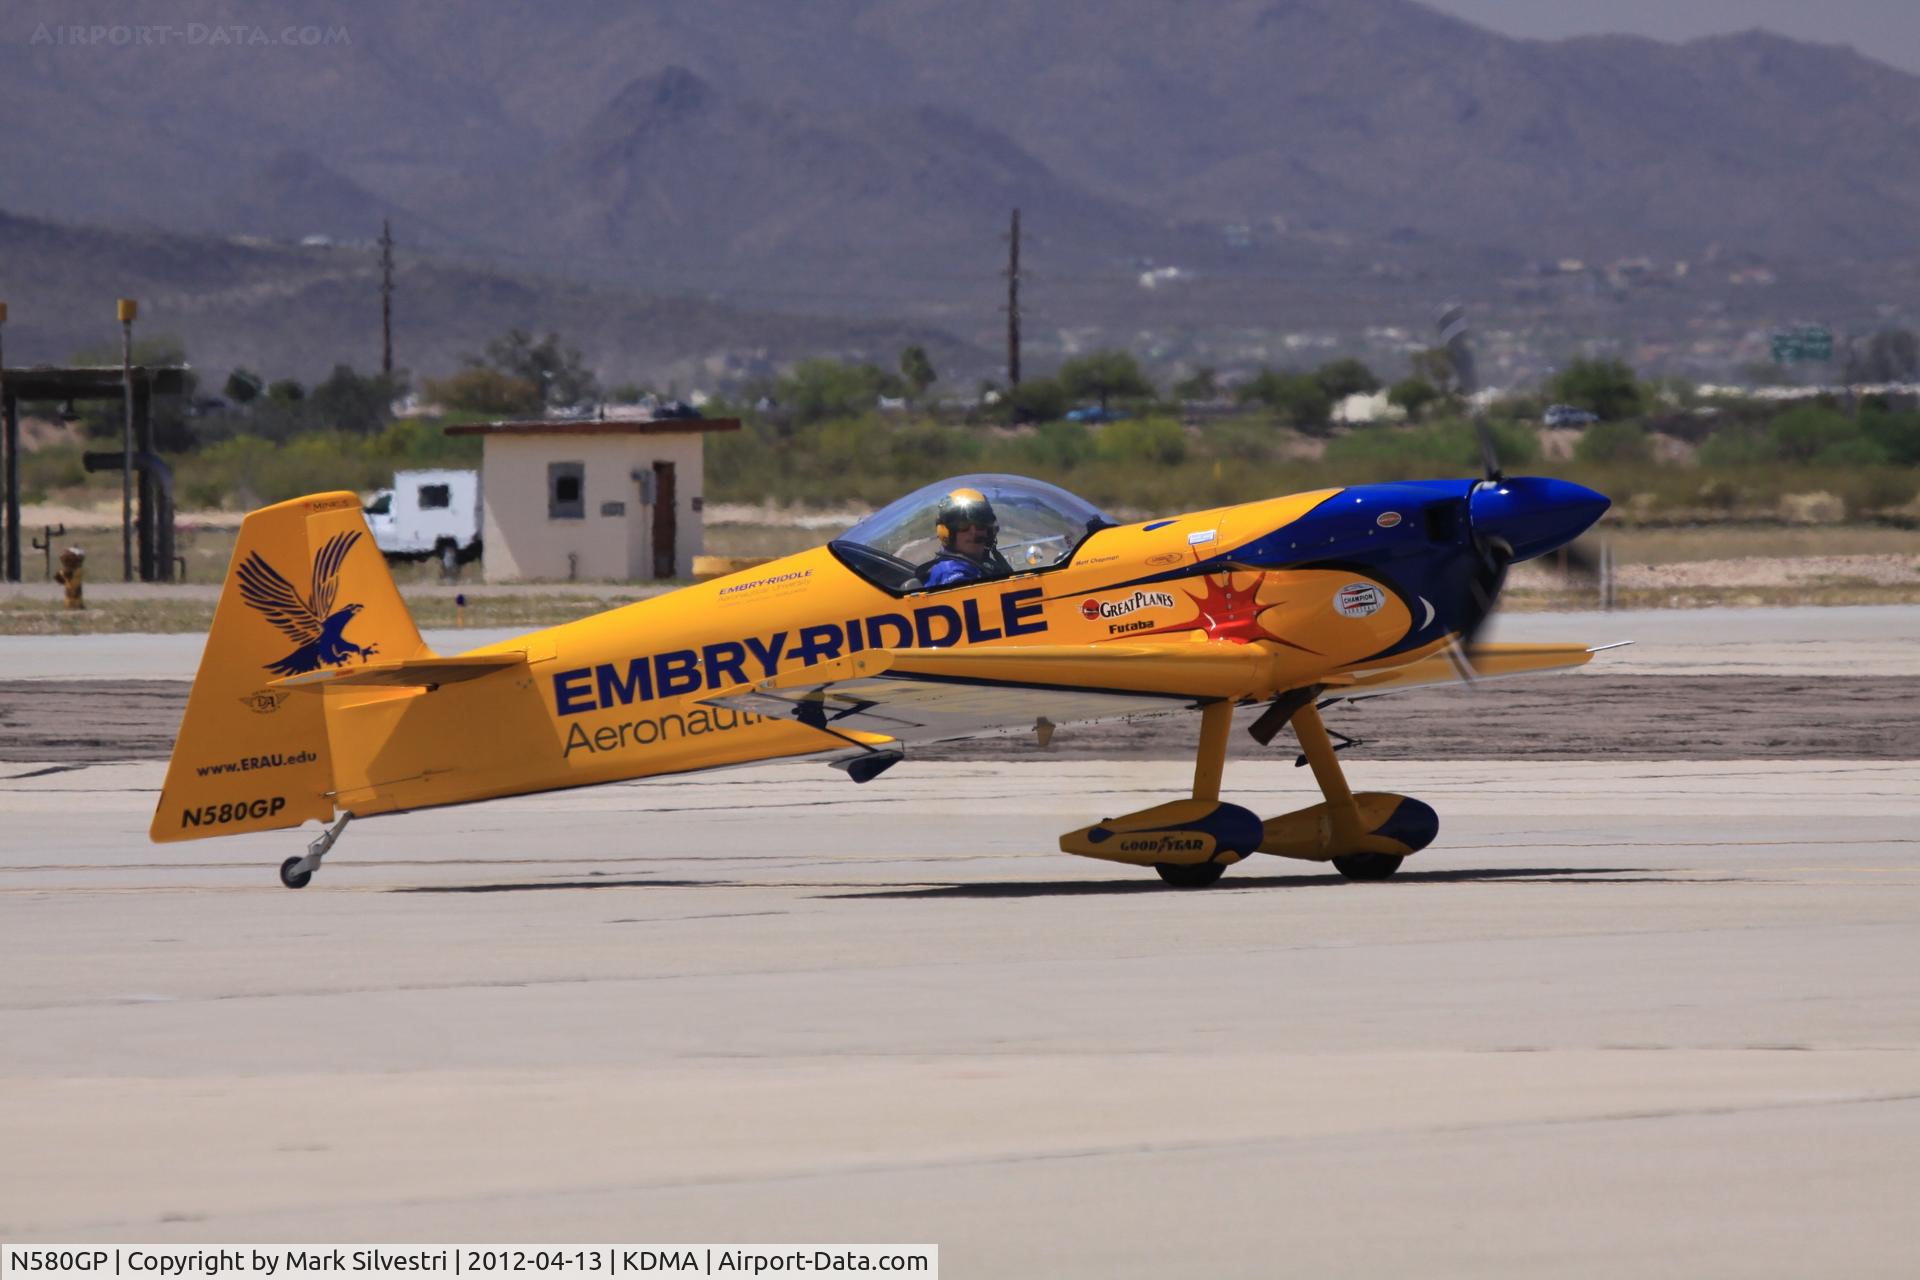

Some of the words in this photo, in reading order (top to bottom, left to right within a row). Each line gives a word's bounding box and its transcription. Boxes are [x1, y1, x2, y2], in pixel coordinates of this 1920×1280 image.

[719, 569, 813, 595] EMBRY-RIDDLE
[1344, 593, 1373, 604] CHAMPION
[1108, 620, 1154, 634] Futaba
[553, 587, 1048, 717] EMBRY-RIDDLE
[196, 751, 317, 777] www.ERAU.edu
[181, 797, 286, 828] N580GP
